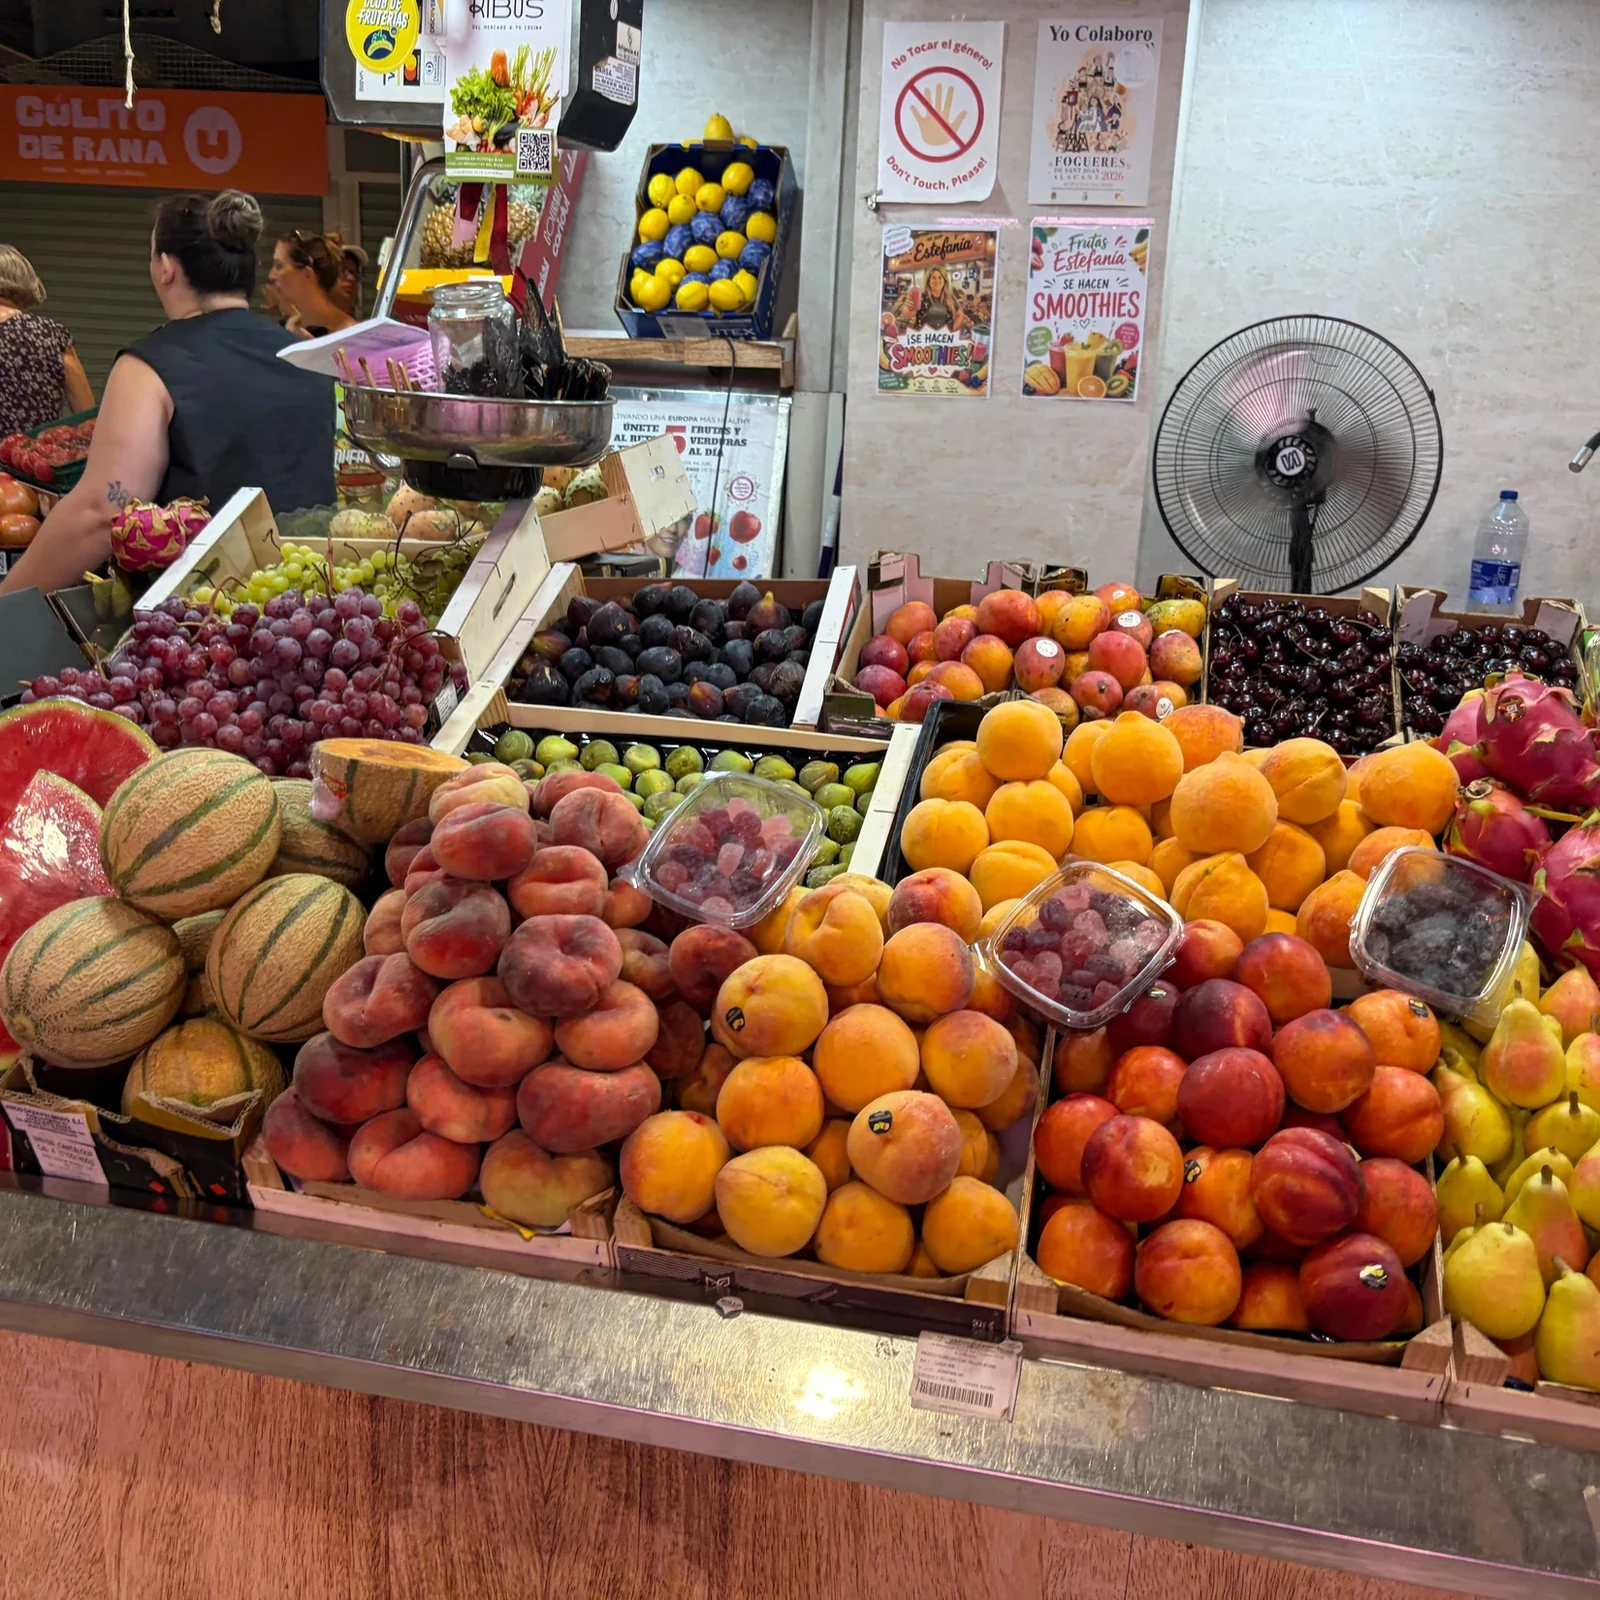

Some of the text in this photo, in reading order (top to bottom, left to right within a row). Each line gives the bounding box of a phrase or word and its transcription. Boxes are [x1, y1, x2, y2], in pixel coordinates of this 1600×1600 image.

[1049, 25, 1153, 42] Yo Colaboro
[891, 39, 993, 70] No Tocar el género!
[18, 134, 169, 165] DE RANA
[1055, 156, 1126, 168] FOGUERES
[886, 155, 988, 190] Don't Touch, Please!
[1068, 233, 1108, 253] Frutas
[1063, 279, 1110, 290] SE HACEN
[1032, 290, 1140, 322] SMOOTHIES
[907, 333, 954, 345] ¡SE HACEN
[891, 343, 975, 370] SMOOTHIES!
[668, 415, 698, 423] EUROPA
[623, 422, 660, 433] ÚNETE
[691, 425, 741, 436] FRUTAS Y
[614, 434, 655, 443] AL RET
[665, 424, 687, 455] 5
[690, 436, 748, 447] VERDURAS
[688, 447, 724, 457] AL DÍA
